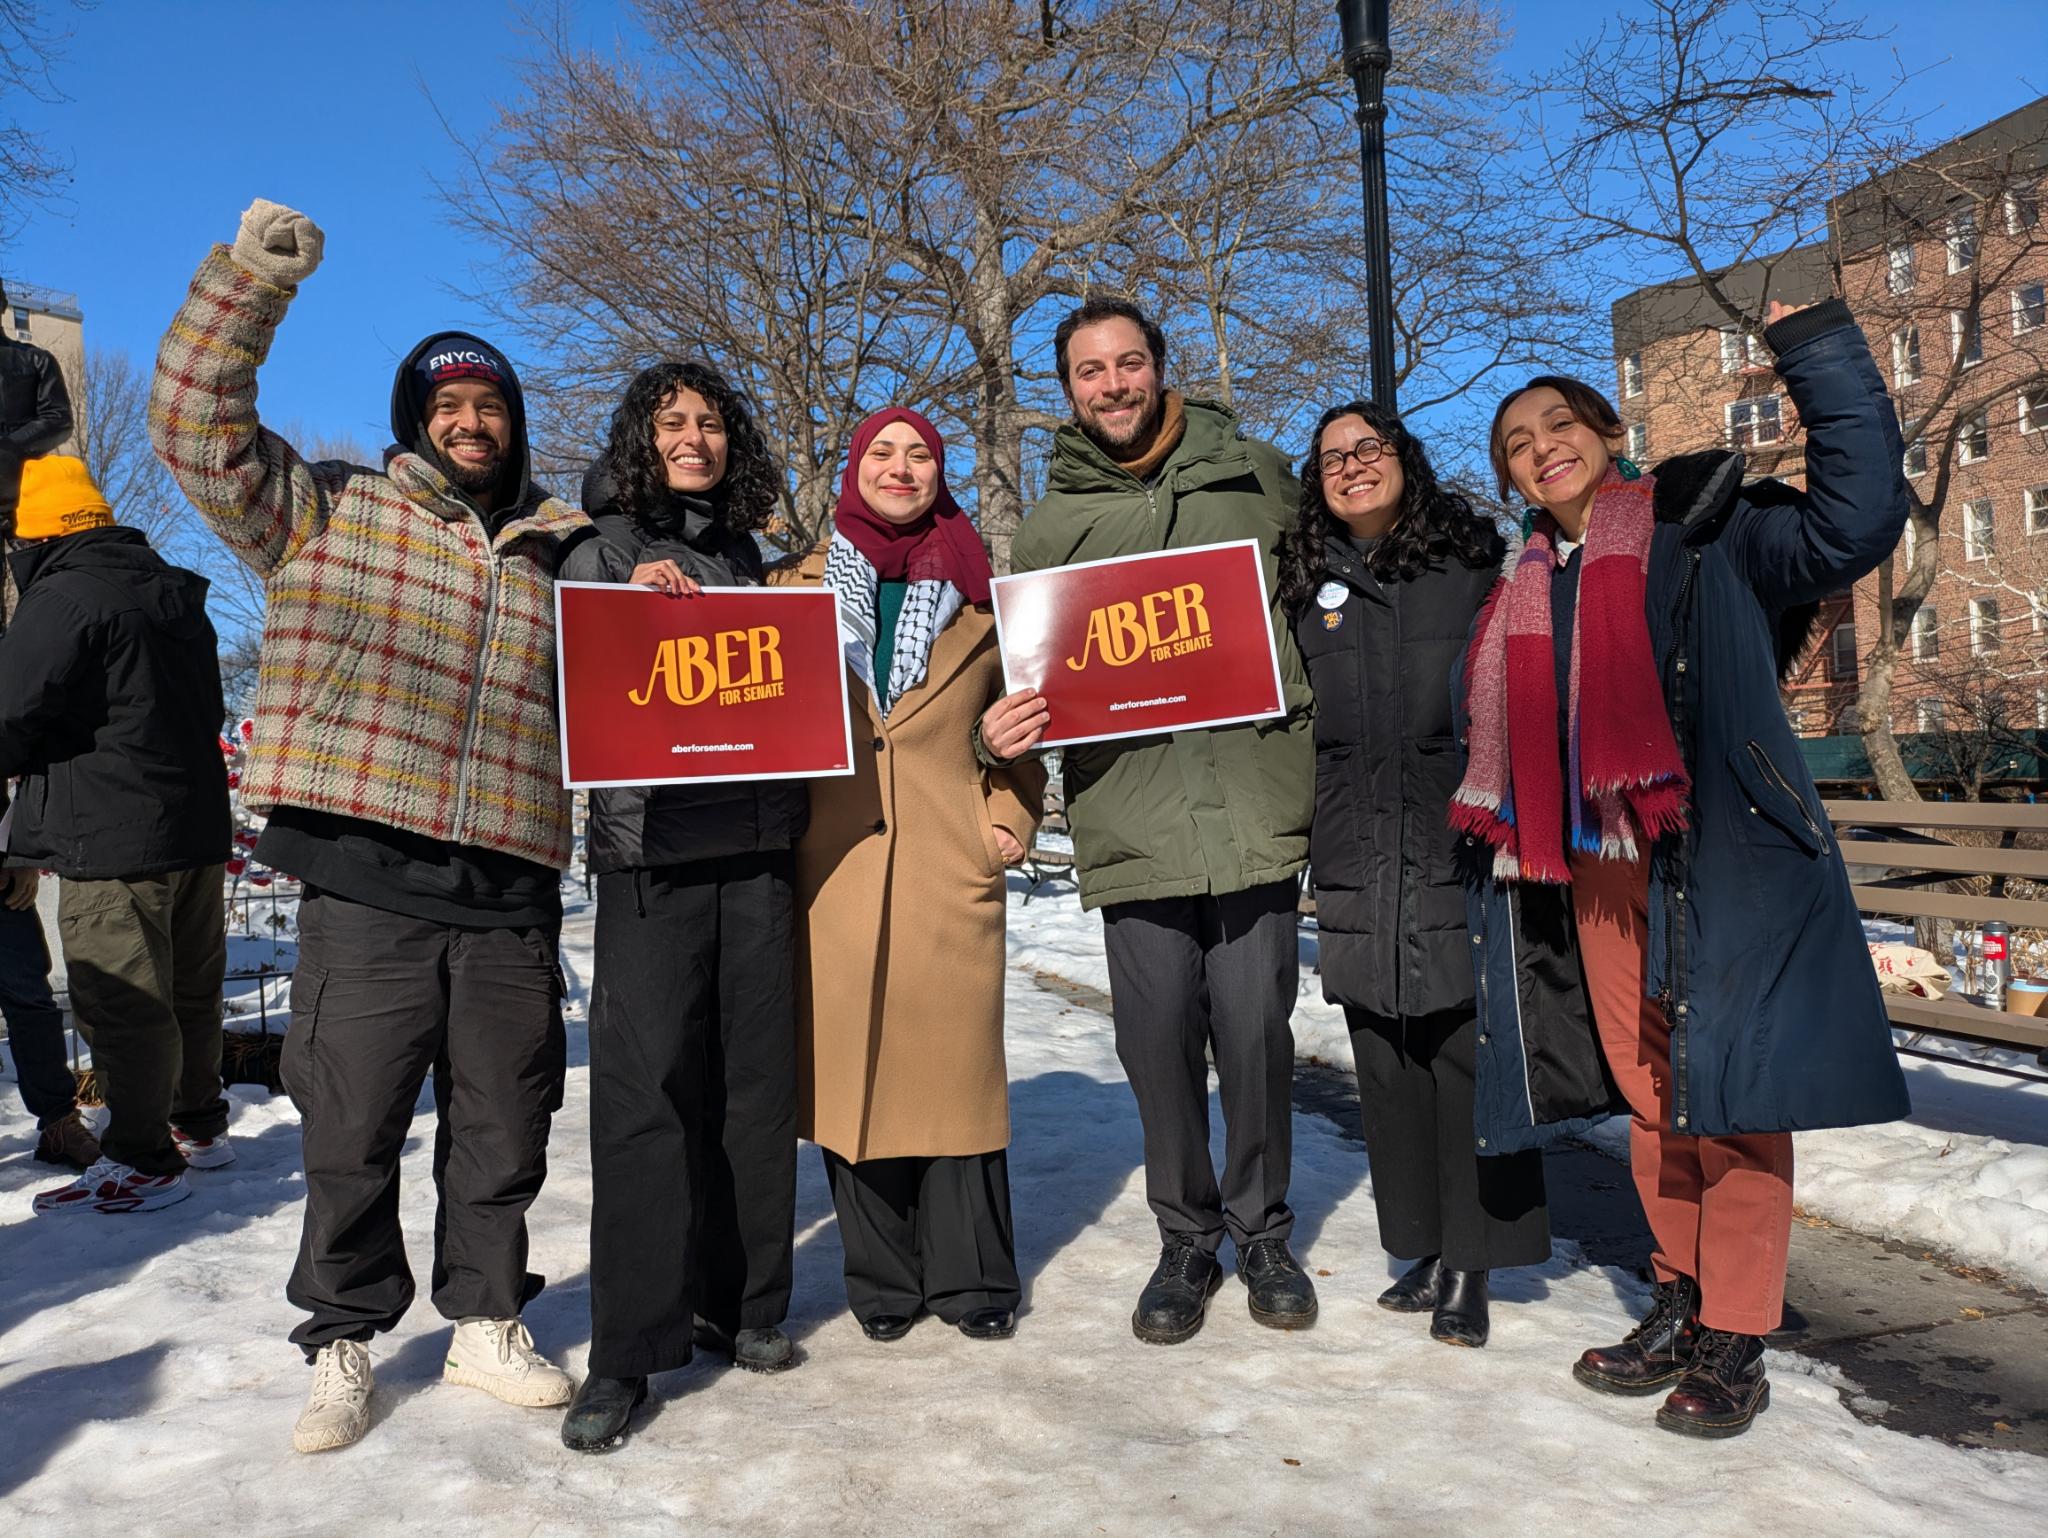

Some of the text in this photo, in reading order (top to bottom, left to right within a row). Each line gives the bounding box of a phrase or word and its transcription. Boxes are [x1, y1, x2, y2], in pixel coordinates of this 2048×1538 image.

[429, 351, 498, 370] ENYCLT
[1065, 582, 1211, 671] ABER
[1150, 633, 1213, 663] FOR SENATE
[628, 625, 783, 706] ABER
[719, 681, 785, 706] FOR SENATE
[1109, 695, 1187, 711] aberforsenate.com
[671, 743, 754, 754] aberforsenate.com
